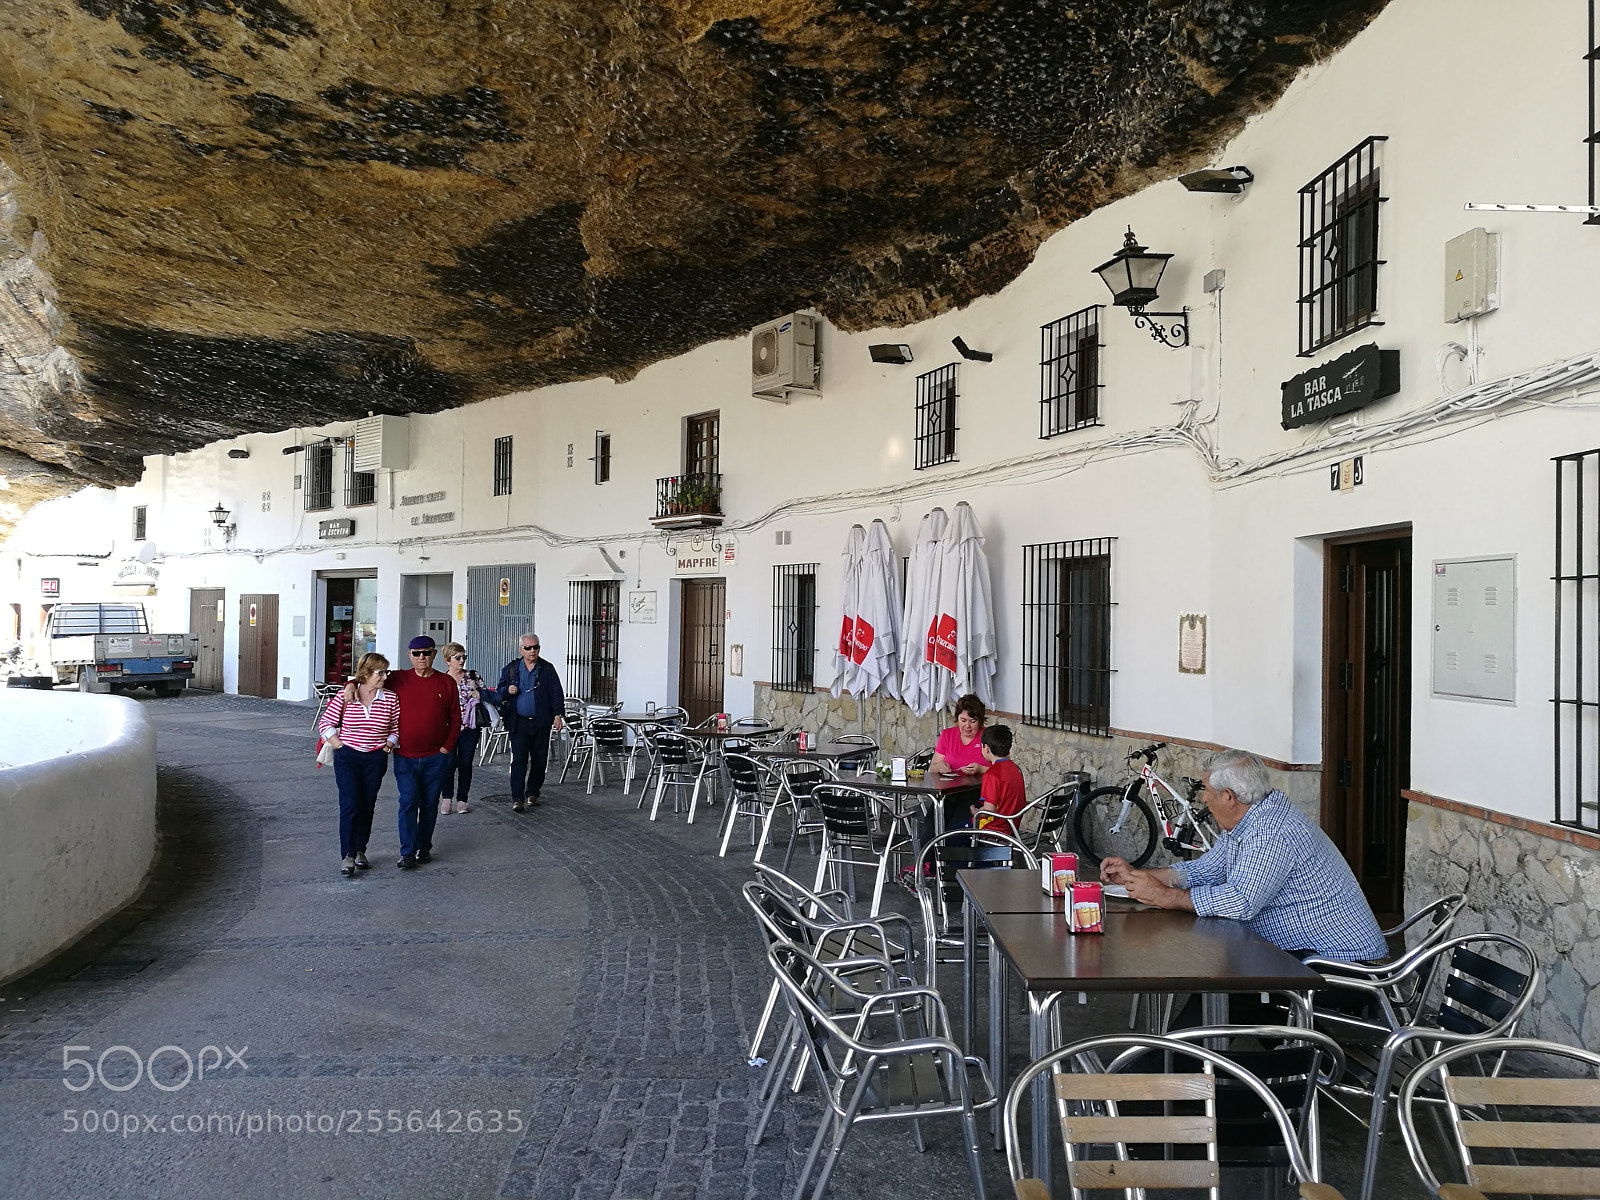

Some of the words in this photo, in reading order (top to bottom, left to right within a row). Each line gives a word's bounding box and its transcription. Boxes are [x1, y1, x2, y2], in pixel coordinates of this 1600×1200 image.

[1304, 375, 1327, 397] BAR
[1291, 401, 1304, 418] LA
[1306, 386, 1342, 412] TASCA
[1331, 465, 1339, 488] 7
[678, 557, 718, 569] MAPFRE
